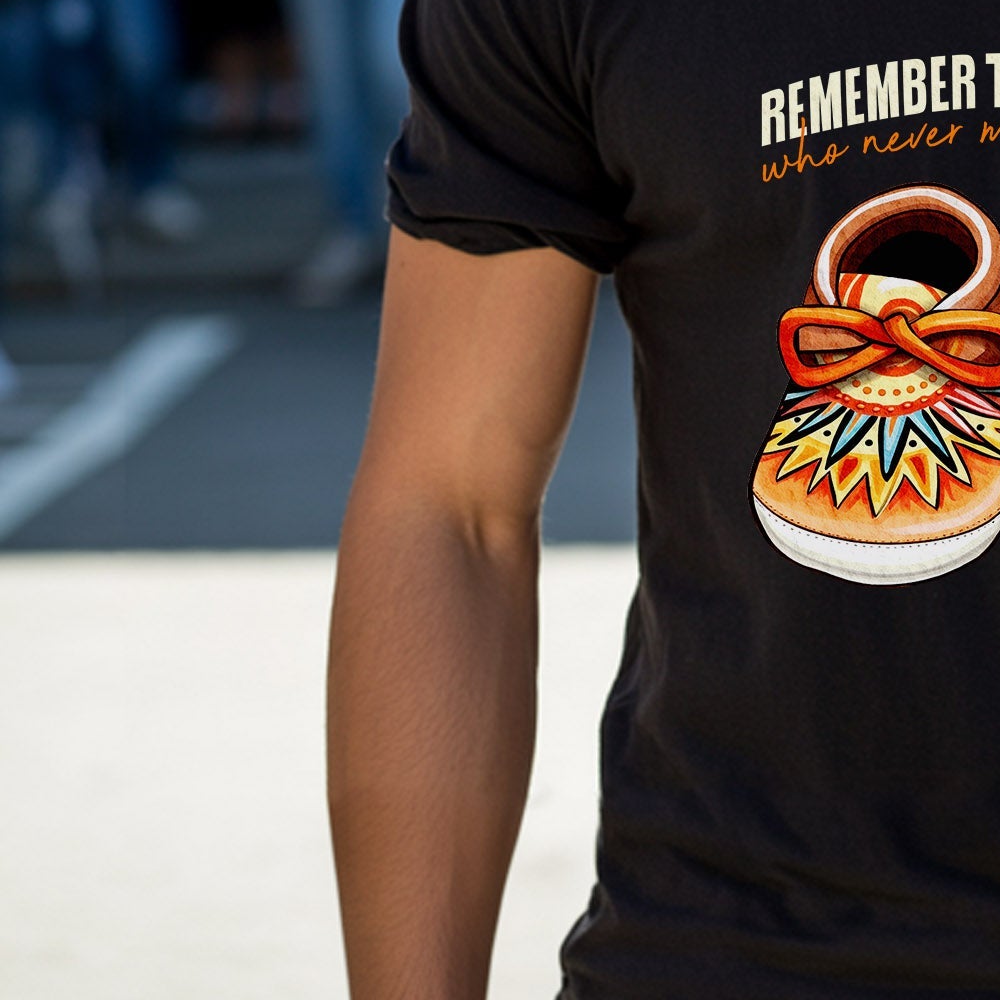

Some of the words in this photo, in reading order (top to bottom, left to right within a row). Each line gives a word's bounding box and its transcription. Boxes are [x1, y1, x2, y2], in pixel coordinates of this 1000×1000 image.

[760, 53, 977, 147] REMEMBER
[761, 116, 850, 182] who
[863, 120, 963, 154] never
